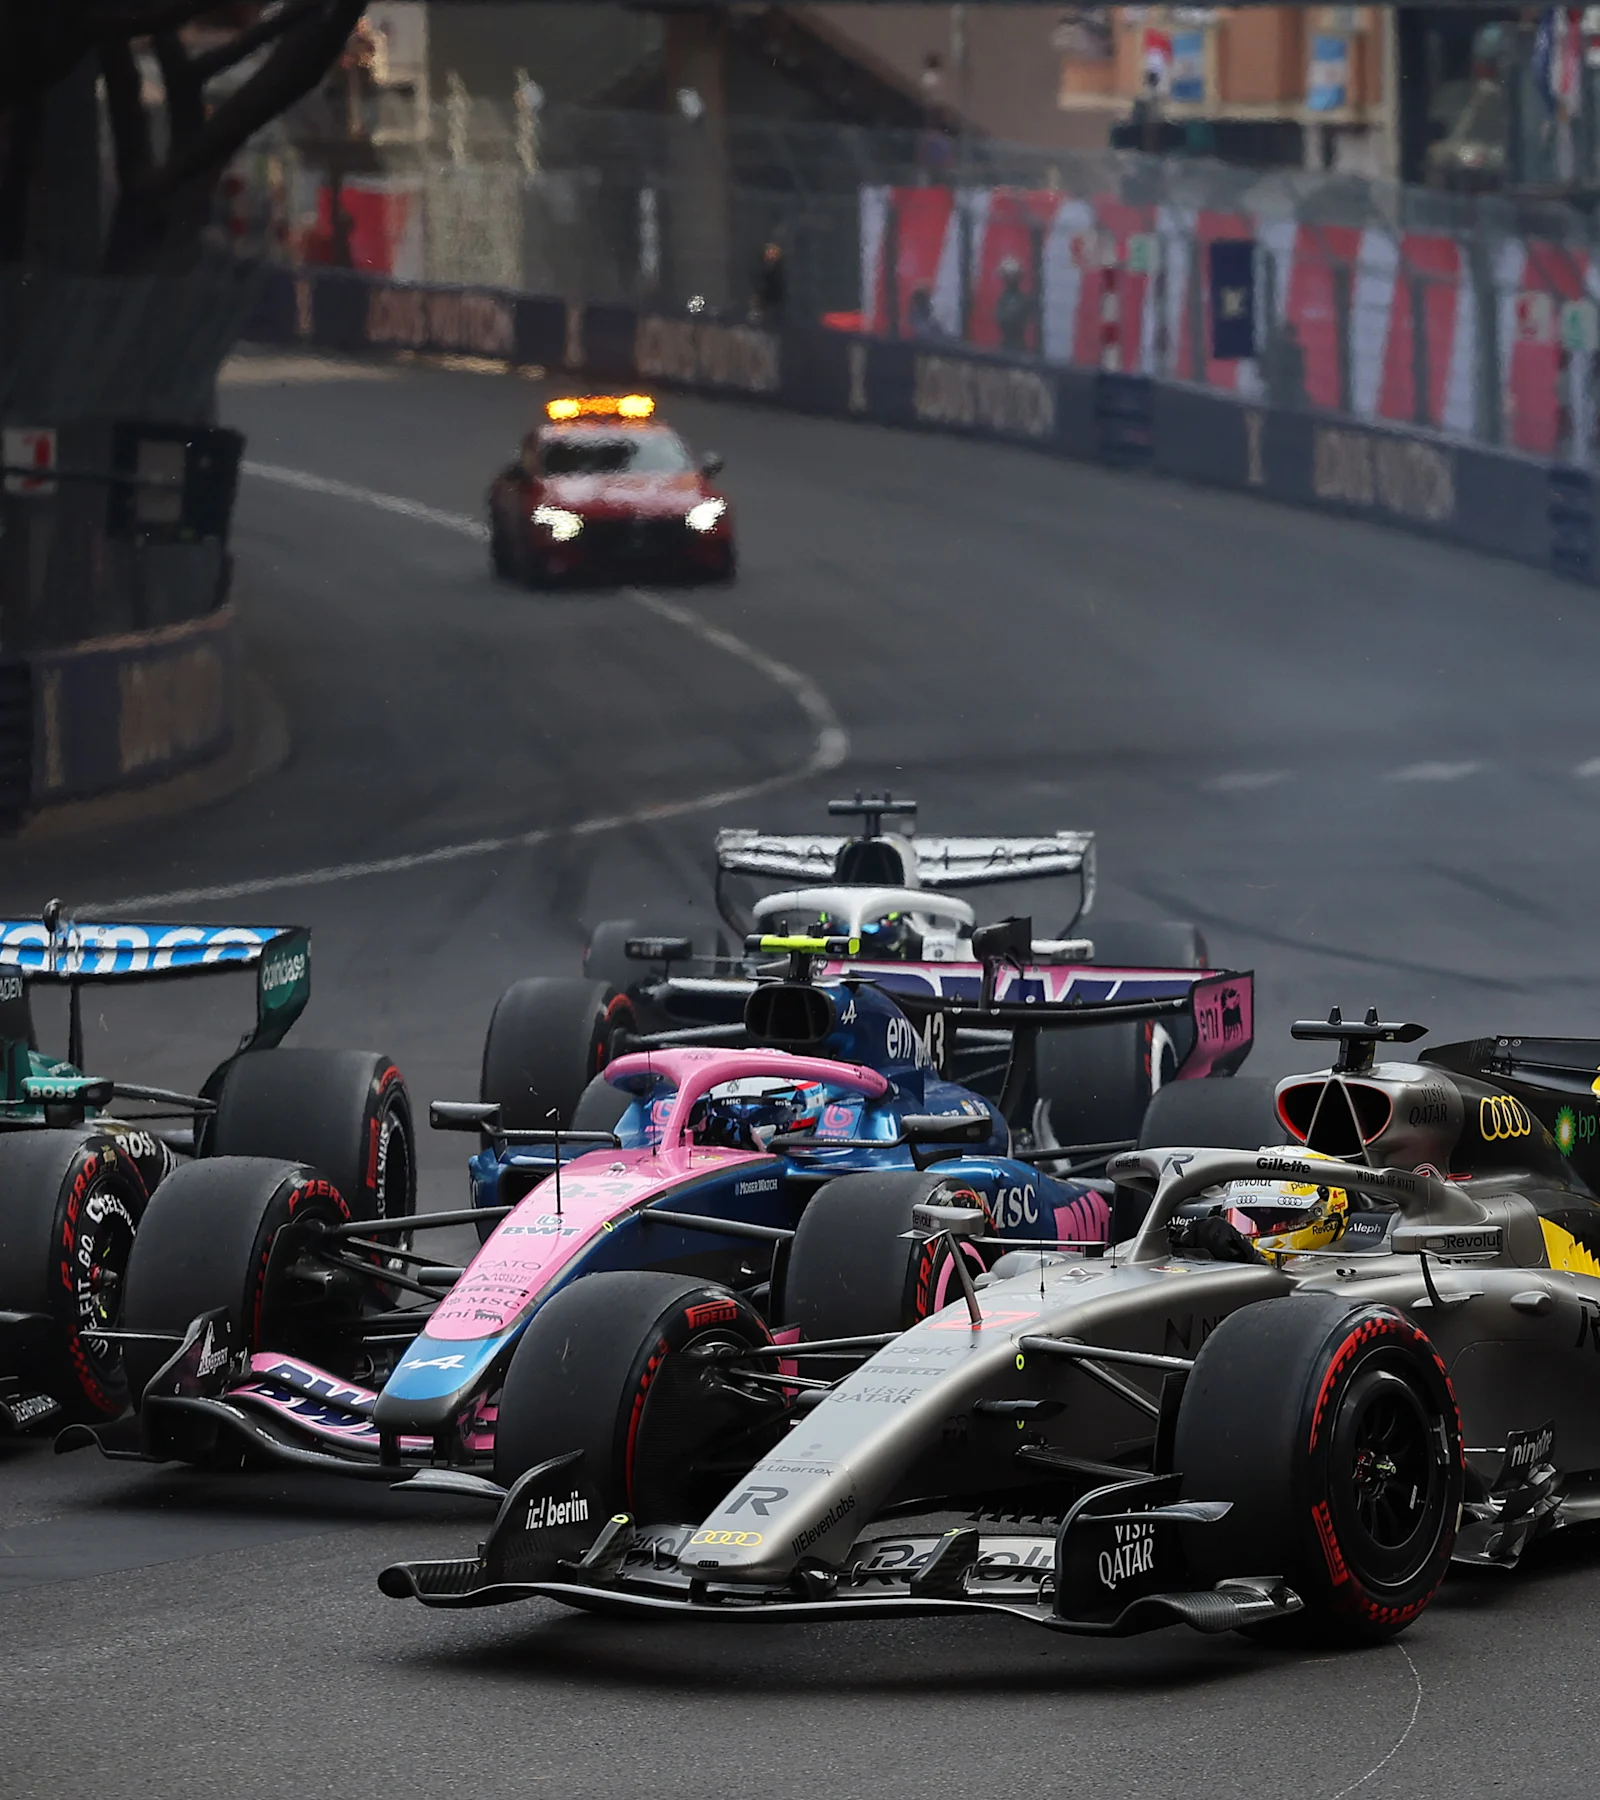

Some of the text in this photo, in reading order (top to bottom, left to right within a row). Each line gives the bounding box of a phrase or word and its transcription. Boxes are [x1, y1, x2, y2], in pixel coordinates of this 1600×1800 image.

[0, 922, 265, 974] amco
[261, 950, 305, 992] coinbase
[1199, 993, 1219, 1042] eni
[886, 1018, 912, 1058] eni
[29, 1085, 77, 1099] BOSS
[1409, 1103, 1448, 1128] QATAR
[1578, 1110, 1596, 1144] bp
[115, 1131, 158, 1158] BOSS
[1115, 1157, 1140, 1169] Gillette
[1256, 1157, 1311, 1174] Gillette
[1355, 1170, 1416, 1192] WORLD OF HYATT
[289, 1179, 351, 1219] P ZERO
[980, 1184, 1039, 1230] MSC
[61, 1154, 98, 1291] P ZERO
[499, 1226, 582, 1238] BWT
[1348, 1222, 1382, 1235] Aleph
[1446, 1232, 1501, 1249] Revolut
[478, 1260, 541, 1271] CATO
[450, 1284, 530, 1298] PIRELLI
[466, 1297, 521, 1310] MSC
[431, 1309, 471, 1321] eni
[685, 1300, 738, 1330] PIRELLI
[928, 1310, 1041, 1331] 27
[884, 1347, 954, 1355] perk
[860, 1366, 947, 1376] PIRELLI
[828, 1393, 913, 1404] QATAR
[863, 1386, 922, 1395] visit
[766, 1464, 835, 1477] Libertex
[525, 1490, 589, 1530] ic! berlin
[725, 1486, 789, 1516] R
[1311, 1500, 1349, 1587] PIRELLI
[856, 1545, 1056, 1586] Reolu
[1099, 1538, 1155, 1590] QATAR
